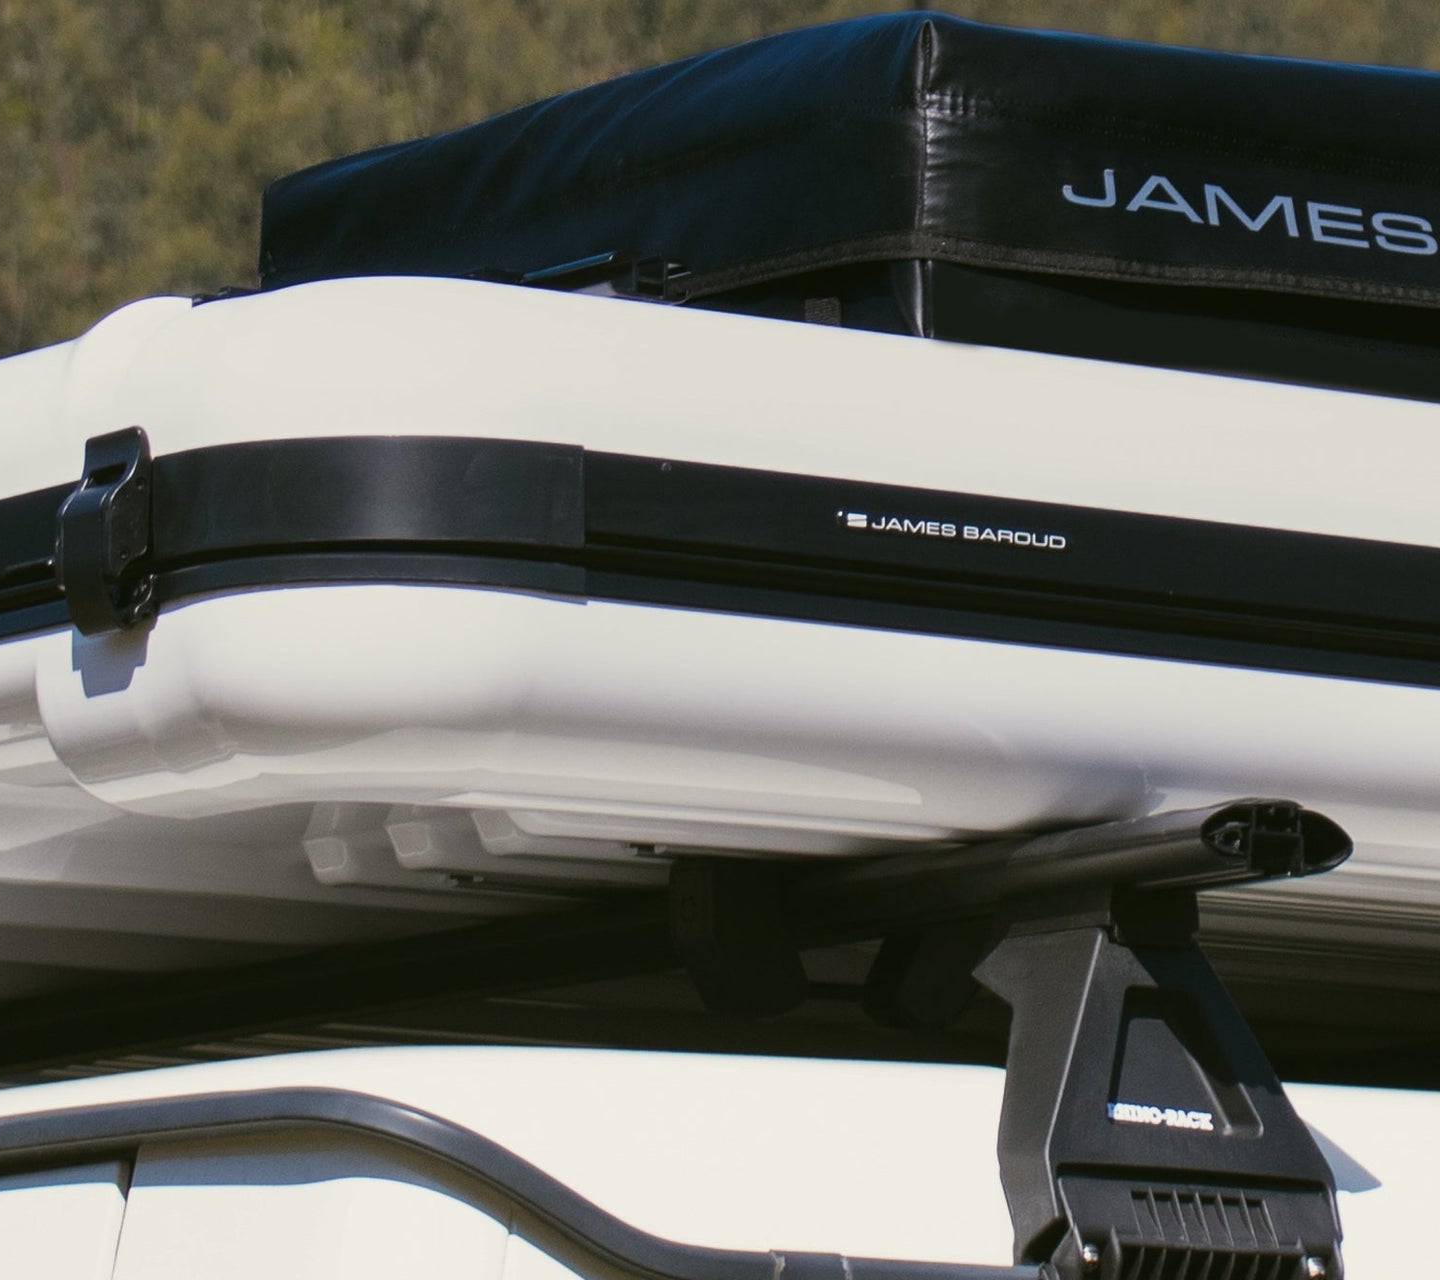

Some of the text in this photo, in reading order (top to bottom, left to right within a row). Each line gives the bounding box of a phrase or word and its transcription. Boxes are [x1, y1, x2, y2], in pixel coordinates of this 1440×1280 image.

[1061, 168, 1438, 257] JAMES
[871, 517, 1067, 550] JAMES BAROUD
